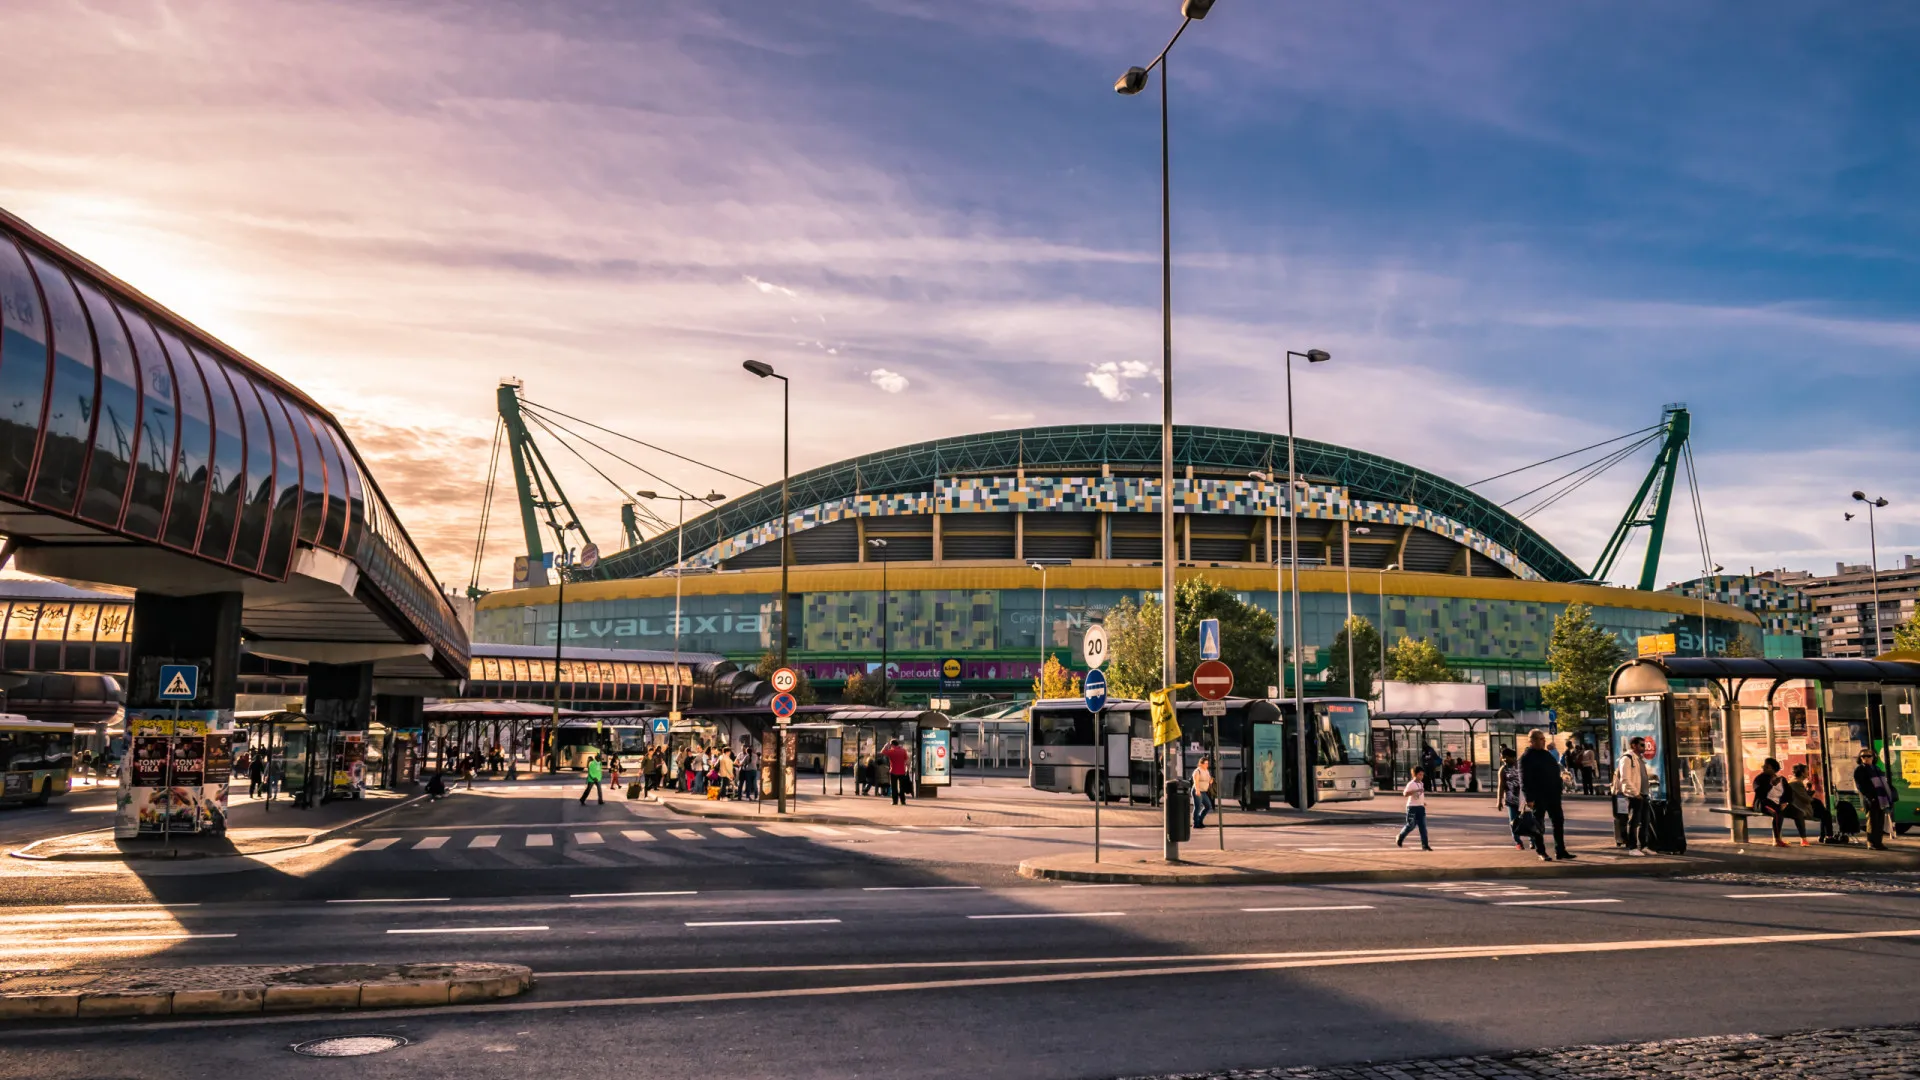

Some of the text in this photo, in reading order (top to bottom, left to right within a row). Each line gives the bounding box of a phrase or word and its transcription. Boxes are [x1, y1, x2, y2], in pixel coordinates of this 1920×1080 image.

[1010, 612, 1060, 624] Cinemas
[1088, 639, 1102, 656] 20
[900, 669, 940, 678] pet outle
[777, 676, 792, 685] 20
